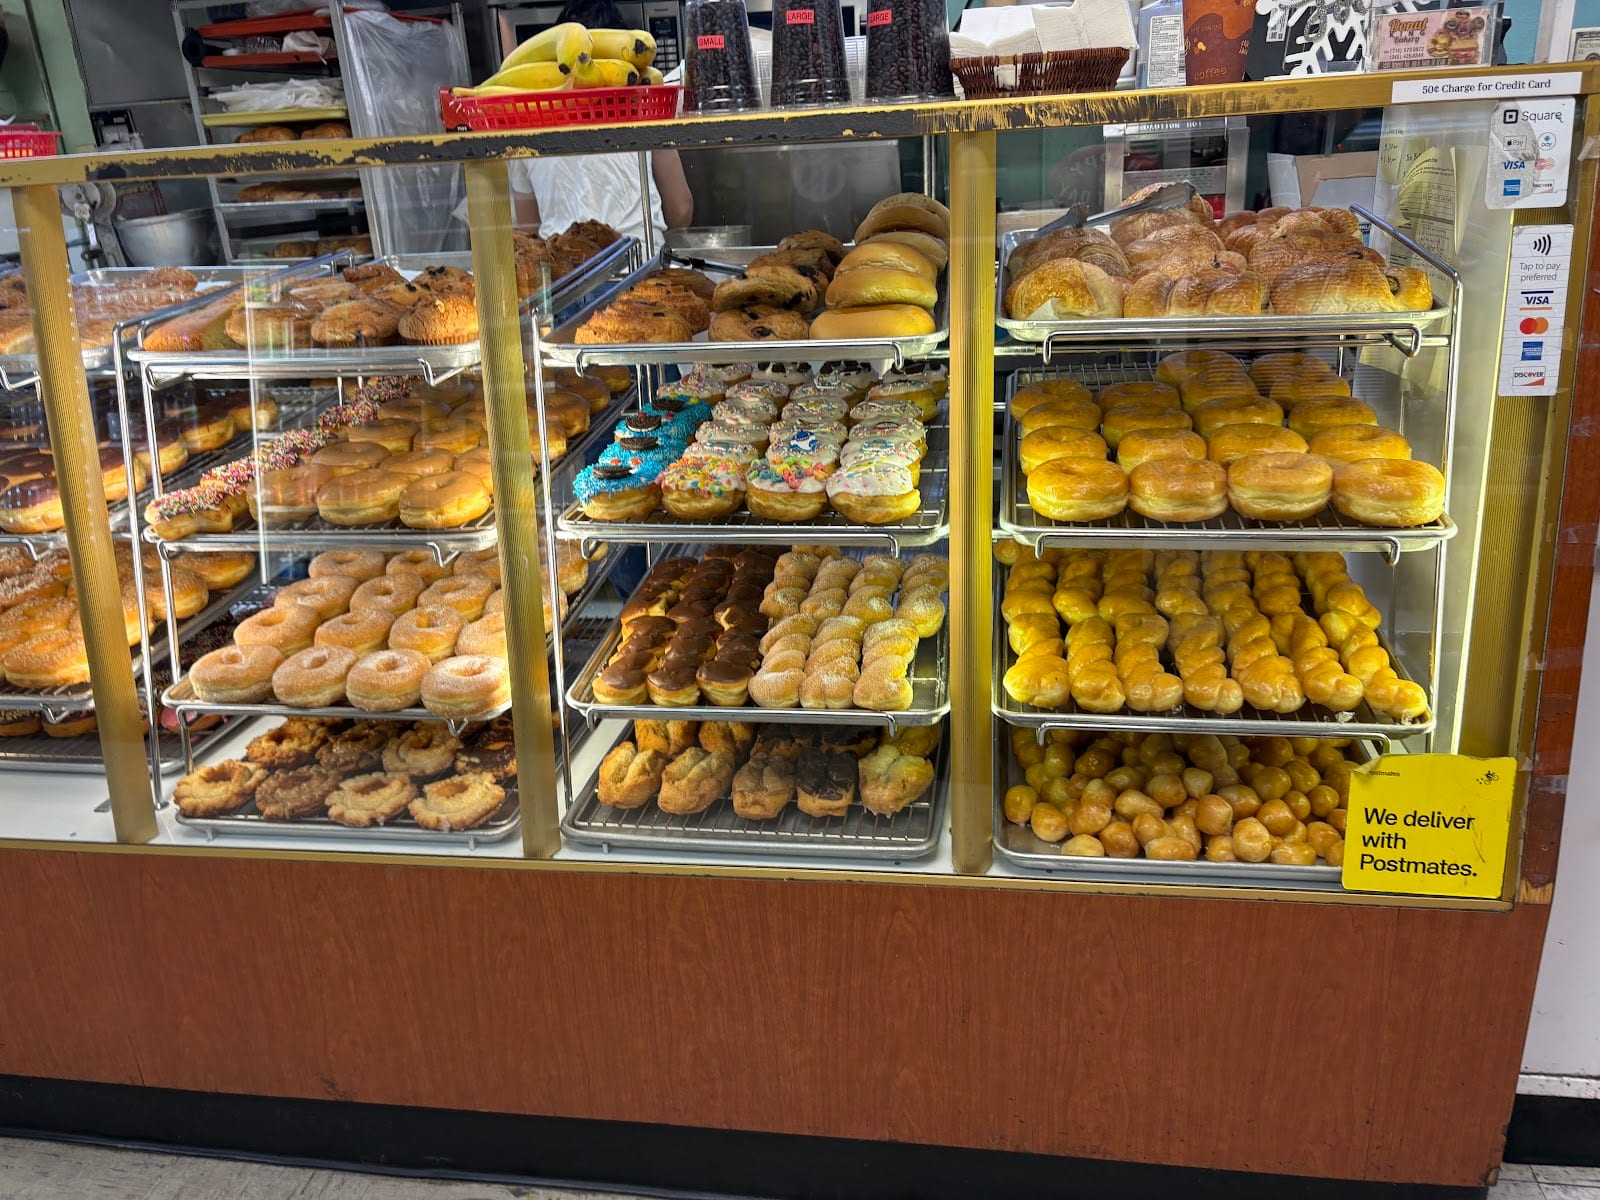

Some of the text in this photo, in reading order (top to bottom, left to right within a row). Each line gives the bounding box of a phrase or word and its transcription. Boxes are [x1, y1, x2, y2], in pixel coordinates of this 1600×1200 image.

[787, 11, 813, 22] LARGE
[869, 12, 889, 23] LARGE
[1389, 18, 1428, 32] Donut
[1389, 30, 1426, 38] KING
[698, 37, 724, 48] SMALL
[1394, 36, 1420, 44] Bakery
[1194, 67, 1227, 81] coffee
[1422, 79, 1552, 95] 50¢ Charge for Credit Card
[1521, 110, 1563, 124] Square
[1503, 160, 1526, 170] VISA
[1519, 262, 1561, 272] Tap to pay
[1520, 272, 1557, 283] preferred
[1524, 296, 1550, 305] VISA
[1514, 371, 1544, 379] DISCOVER
[1364, 807, 1476, 830] We deliver
[1361, 832, 1406, 850] with
[1360, 853, 1478, 877] Postmates.
